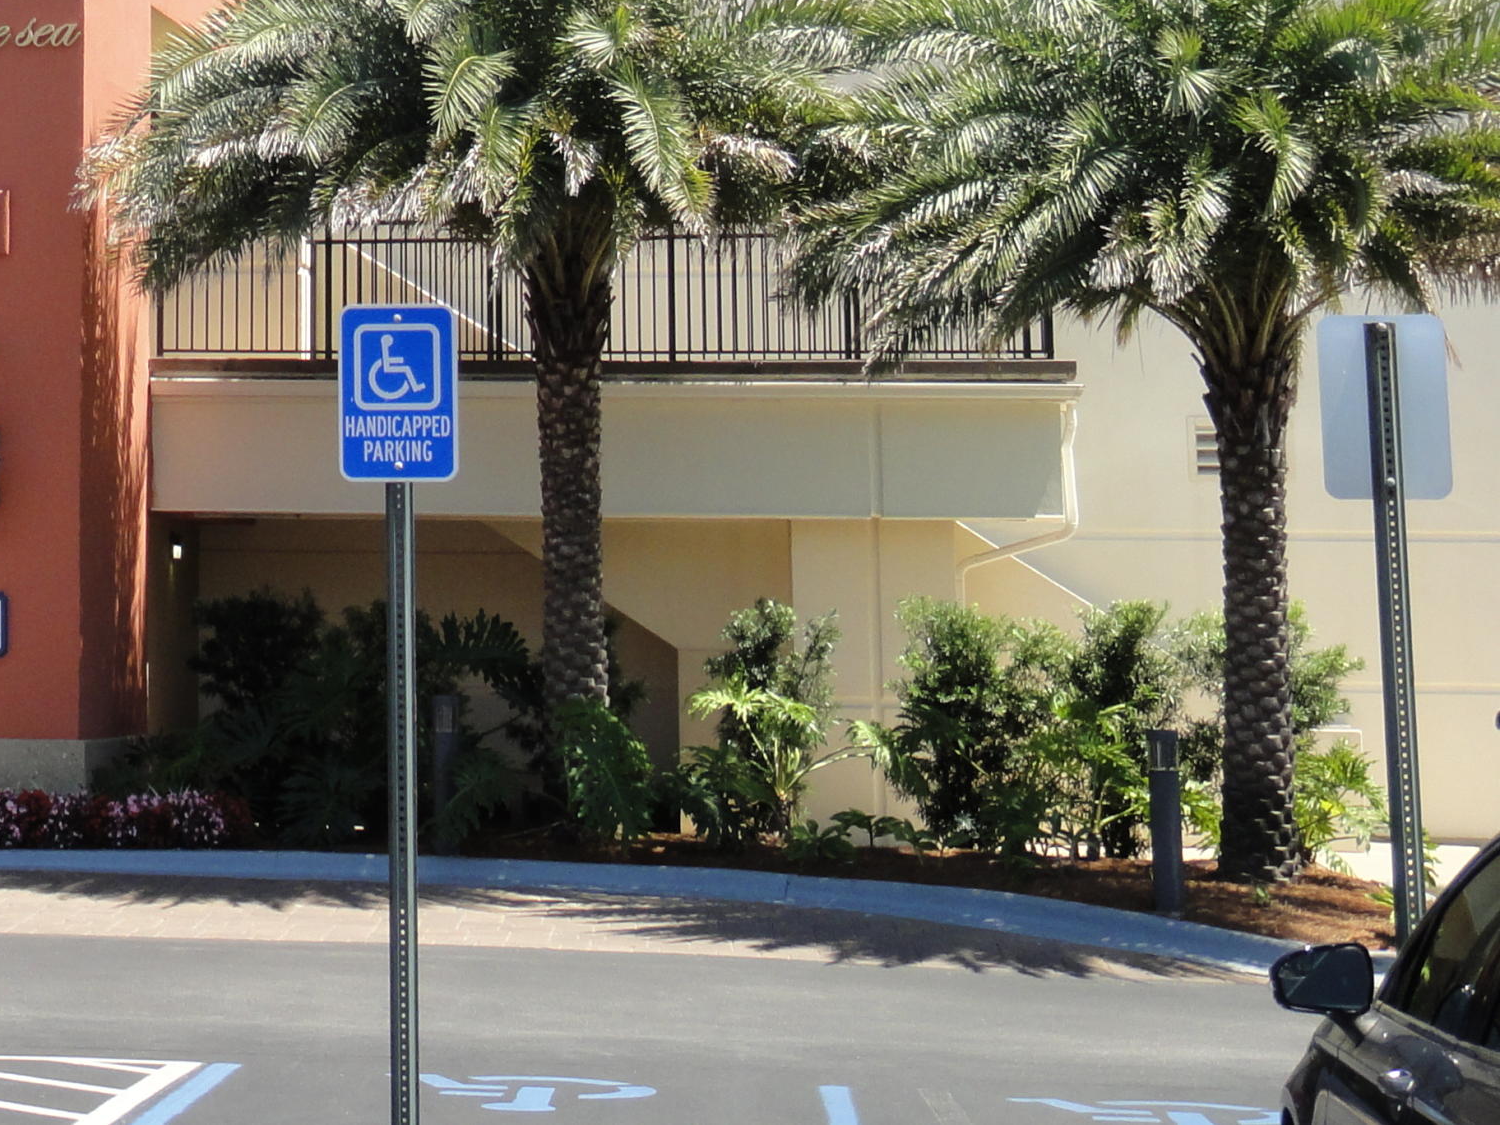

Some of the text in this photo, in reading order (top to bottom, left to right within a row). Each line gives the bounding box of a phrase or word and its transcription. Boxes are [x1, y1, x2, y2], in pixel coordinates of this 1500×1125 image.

[15, 17, 81, 47] sea
[345, 415, 451, 438] HANDICAPPED
[363, 439, 433, 463] PARKING
